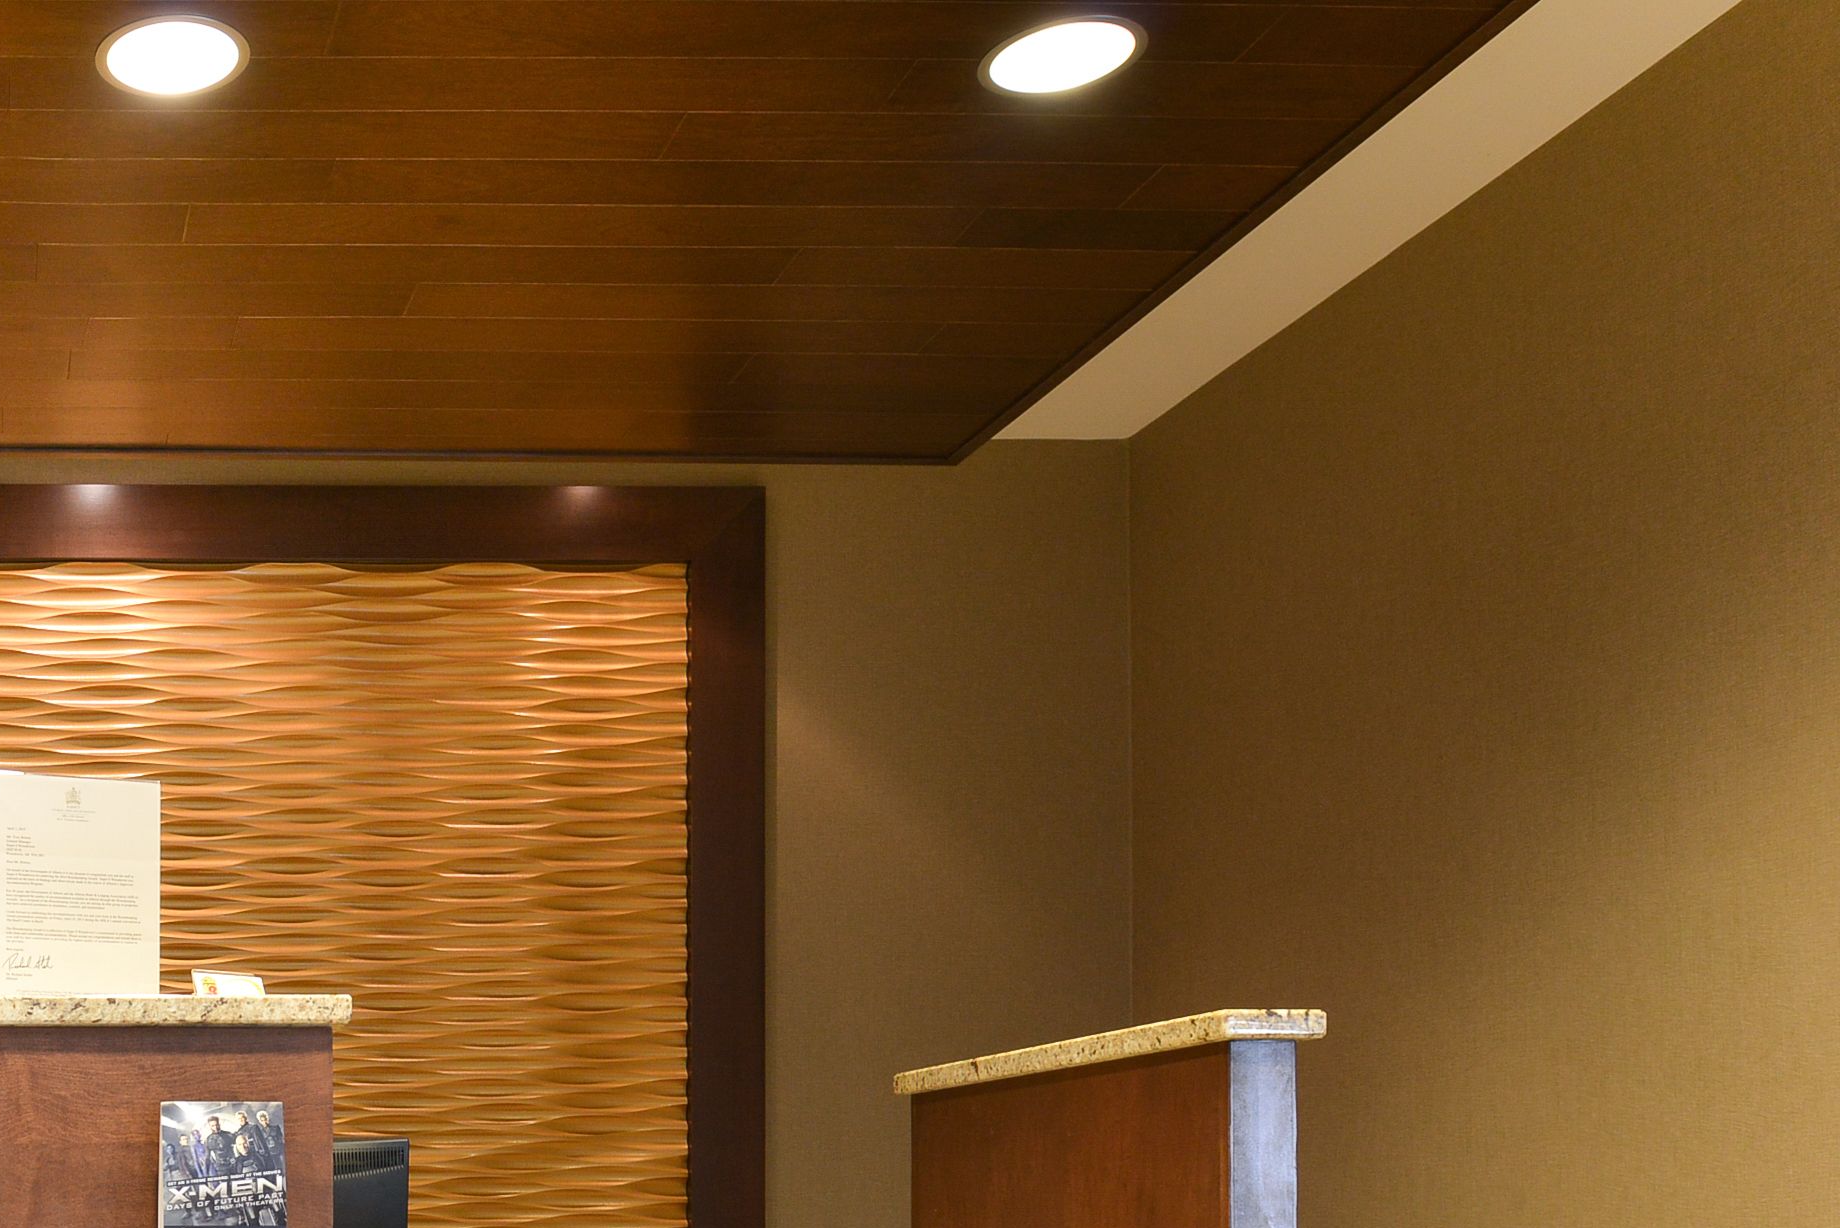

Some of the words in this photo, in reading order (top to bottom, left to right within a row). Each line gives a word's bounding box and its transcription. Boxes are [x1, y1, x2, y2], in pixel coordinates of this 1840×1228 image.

[168, 1174, 283, 1204] X-MEN
[166, 1202, 192, 1211] DAYS
[214, 1196, 255, 1205] FUTURE
